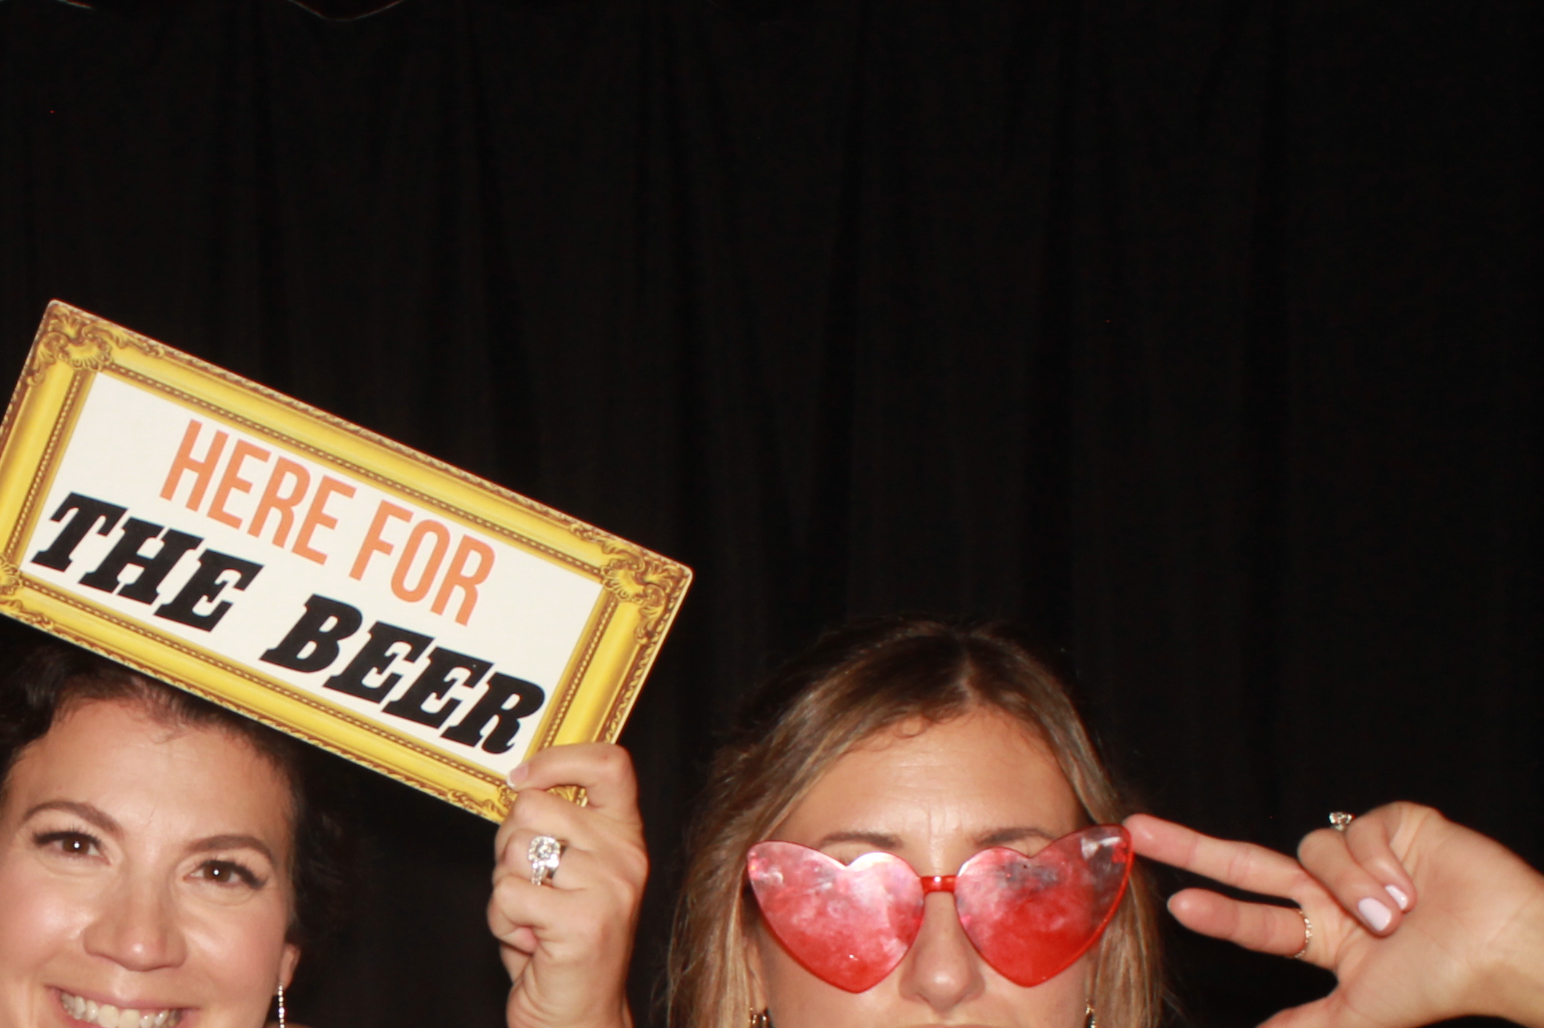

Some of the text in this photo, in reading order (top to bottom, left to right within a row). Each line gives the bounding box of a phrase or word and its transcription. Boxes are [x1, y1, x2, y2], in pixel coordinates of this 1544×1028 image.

[31, 492, 545, 755] THE BEER
[159, 419, 496, 627] HERE FOR
